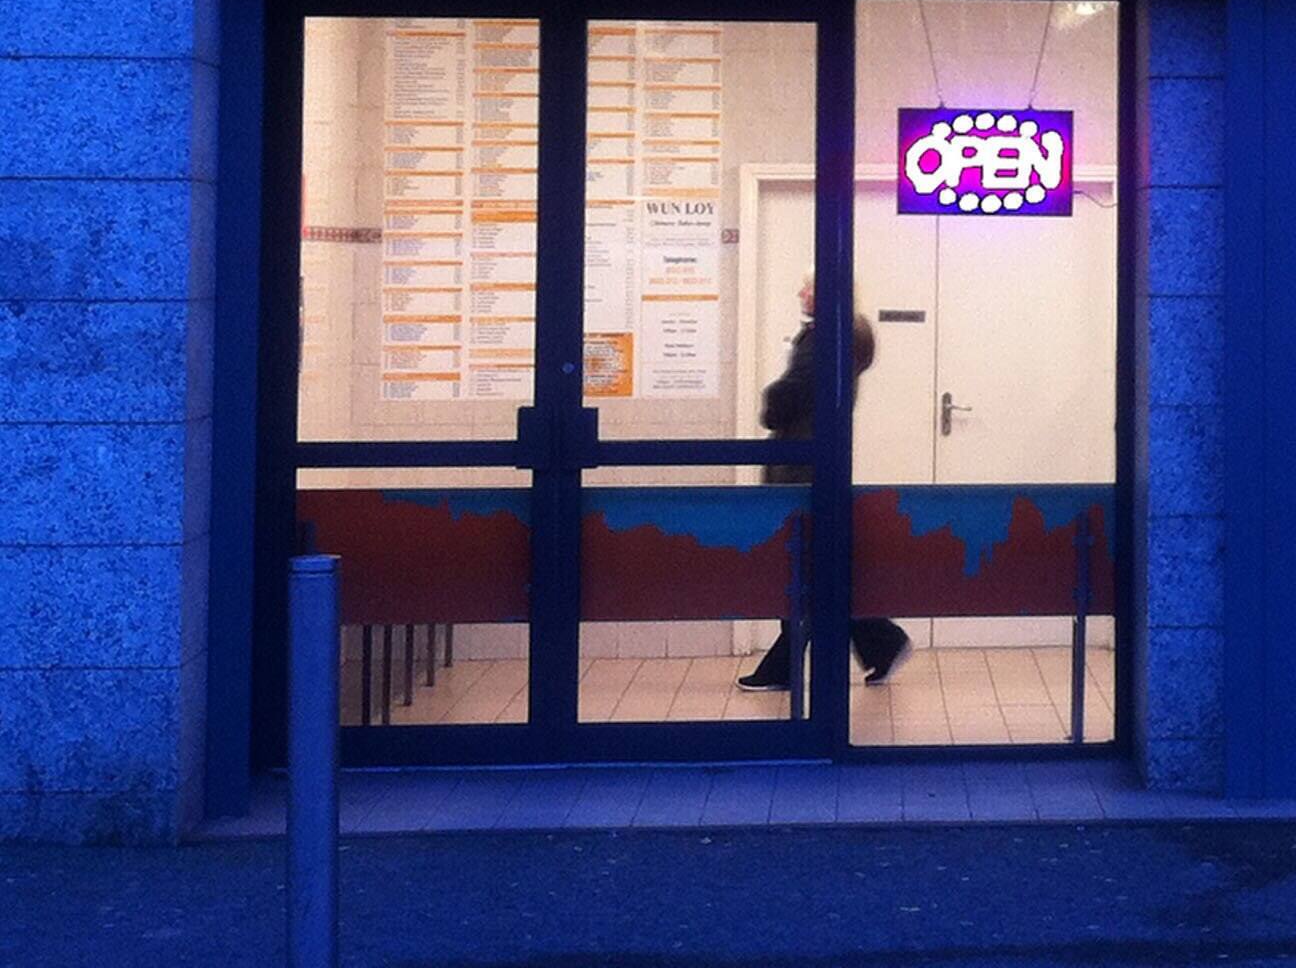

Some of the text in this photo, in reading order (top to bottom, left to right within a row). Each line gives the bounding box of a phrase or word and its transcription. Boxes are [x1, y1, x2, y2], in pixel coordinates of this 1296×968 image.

[905, 130, 1064, 194] OPEN
[646, 202, 714, 215] WUN LOY
